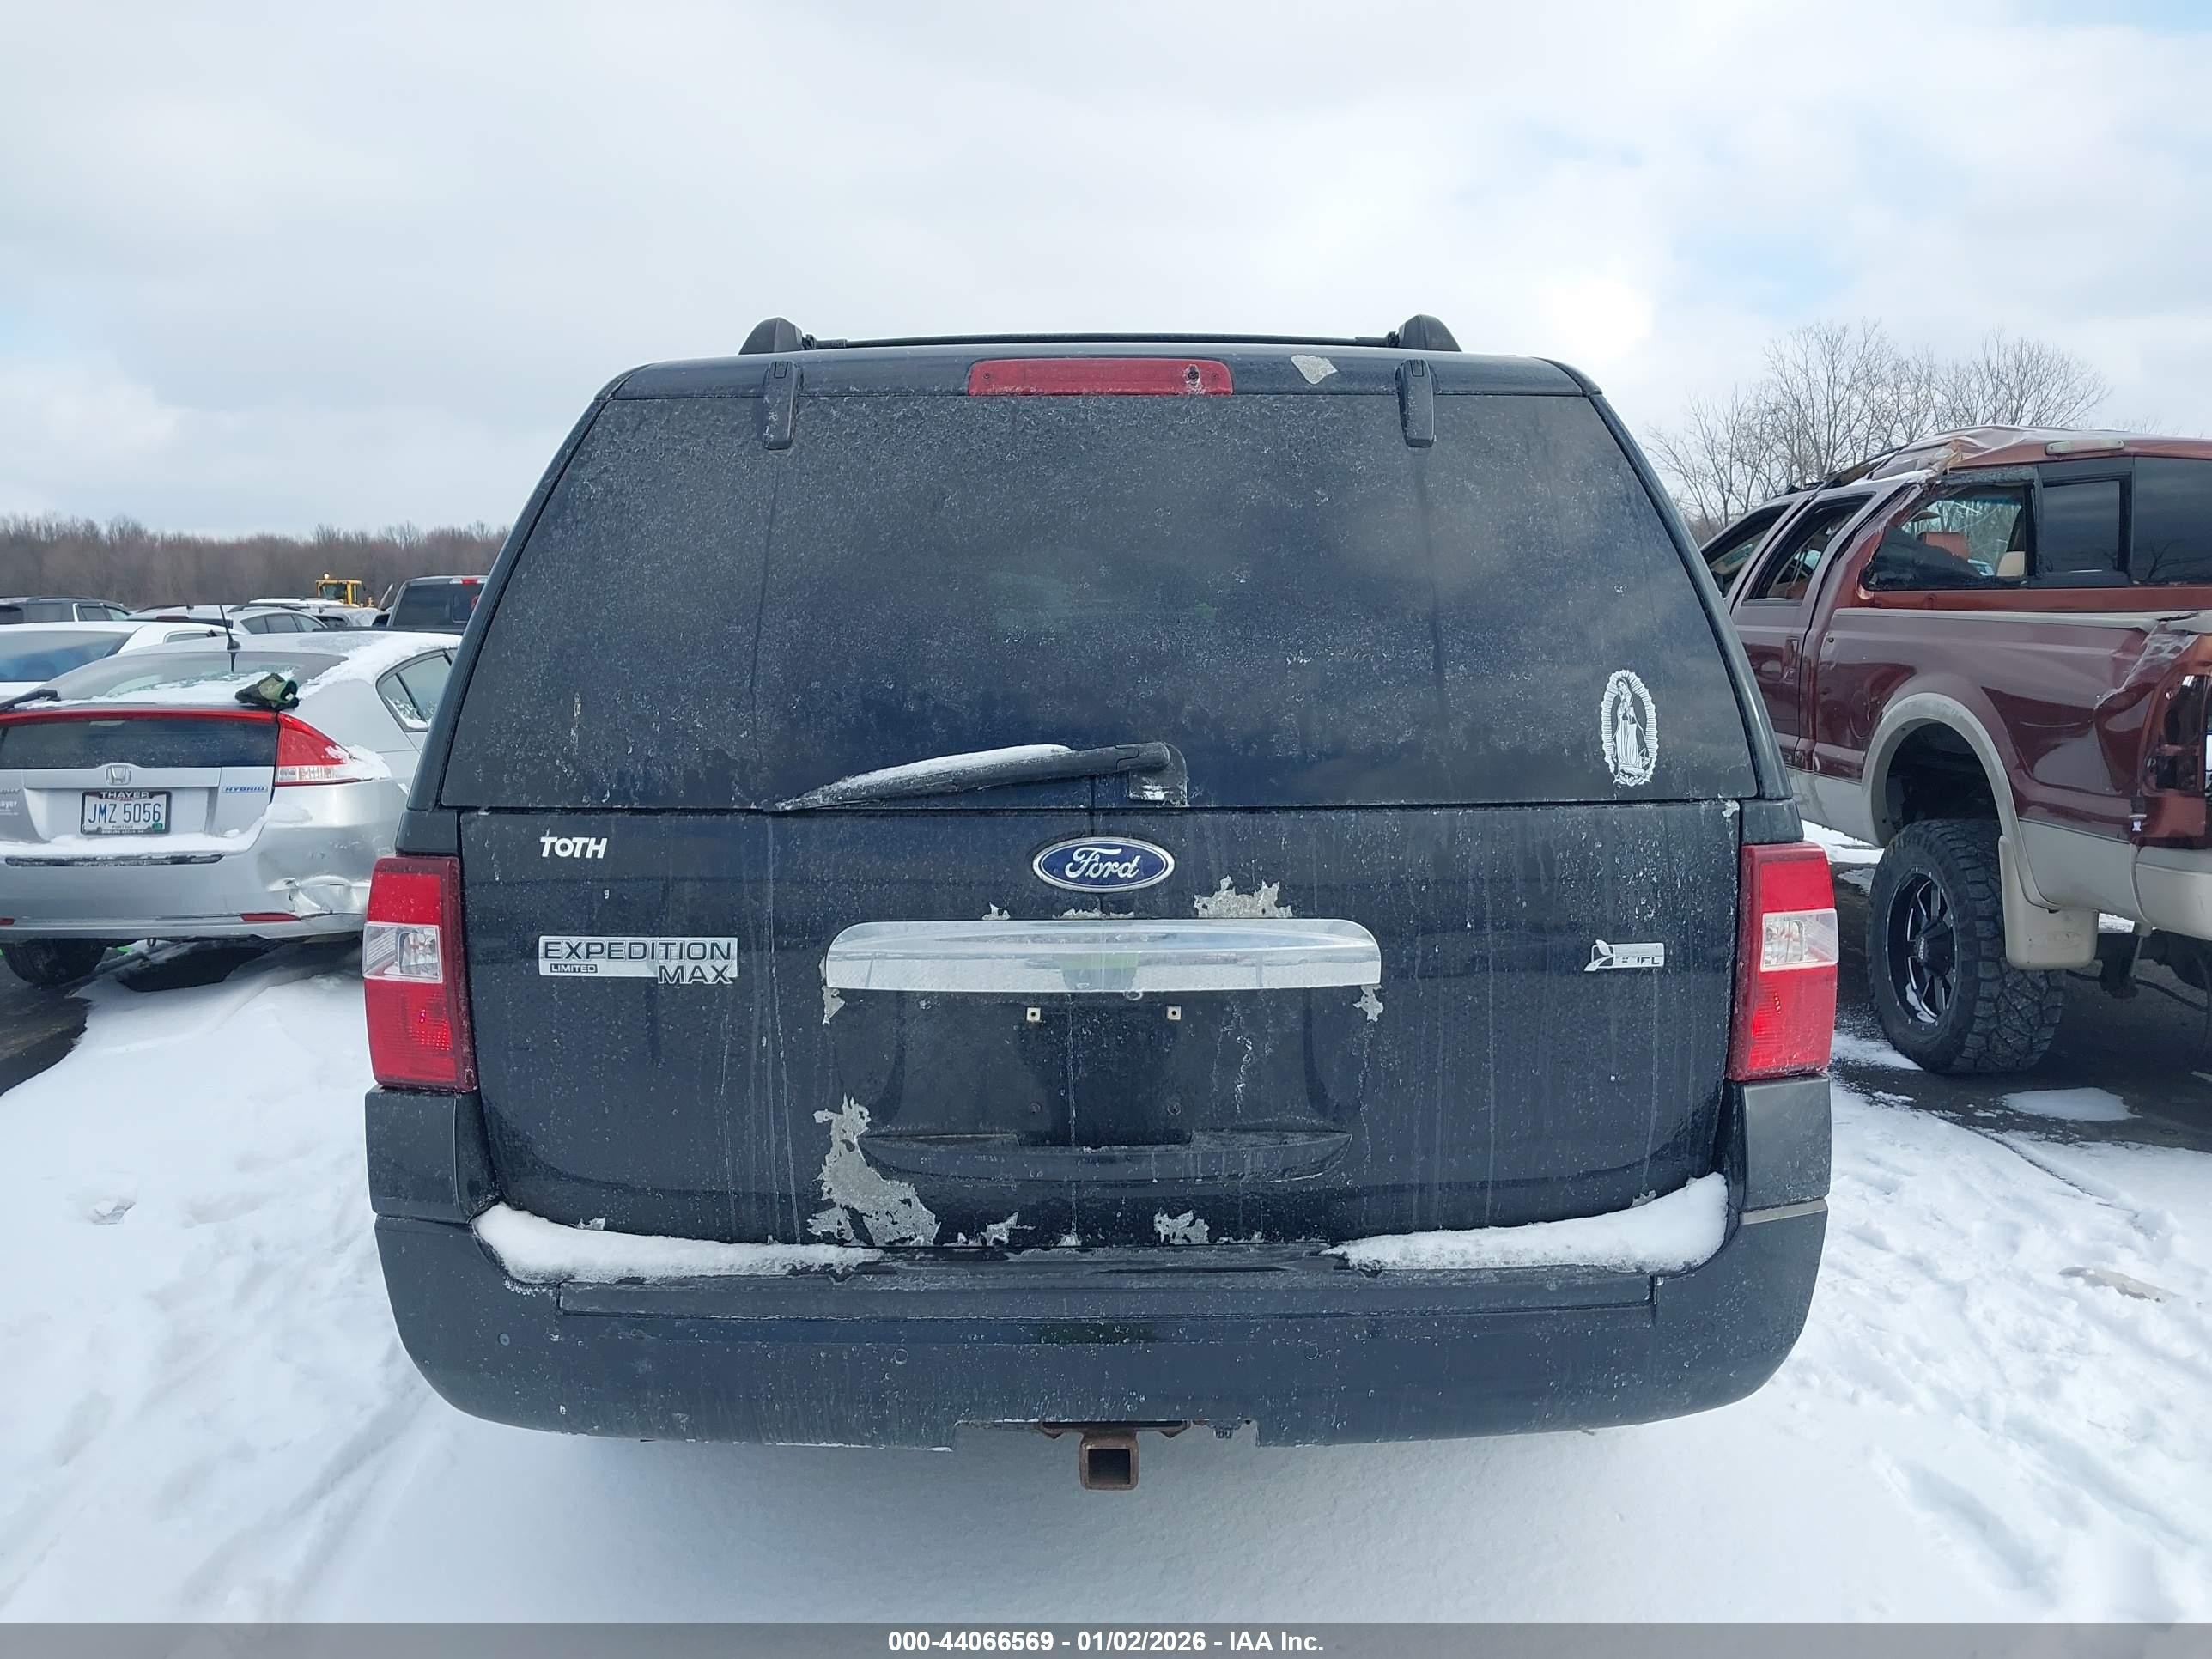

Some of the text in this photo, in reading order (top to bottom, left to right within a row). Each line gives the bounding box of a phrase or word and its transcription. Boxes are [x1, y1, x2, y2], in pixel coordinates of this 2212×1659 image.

[88, 803, 161, 823] JMZ 5056
[540, 836, 608, 859] TOTH
[1065, 847, 1141, 878] Ford
[543, 940, 735, 962] EXPEDITION
[550, 964, 597, 974] LIMITED
[657, 963, 733, 984] MAX
